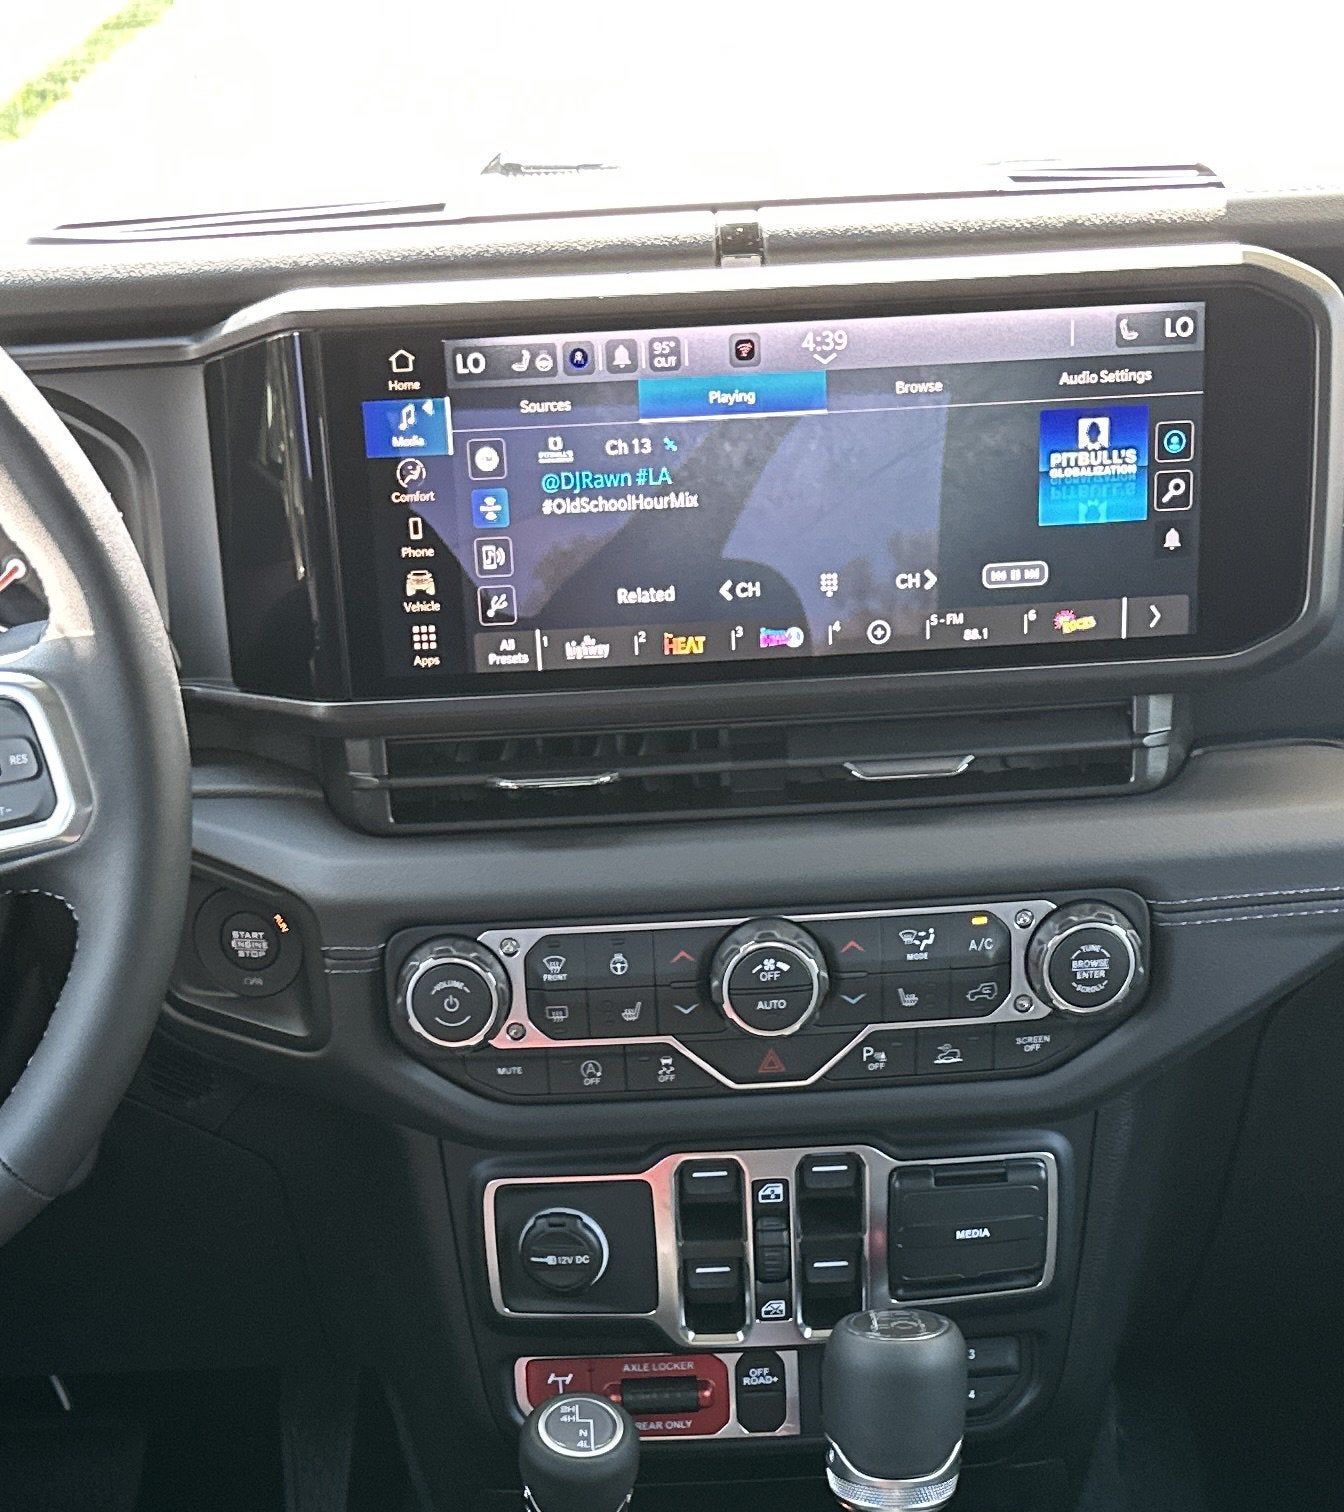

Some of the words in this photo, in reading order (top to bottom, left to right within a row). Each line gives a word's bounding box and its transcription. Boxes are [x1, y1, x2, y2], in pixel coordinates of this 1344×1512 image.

[1164, 316, 1194, 338] LO
[801, 330, 848, 352] 4:39
[653, 341, 676, 355] 95°
[456, 352, 486, 374] LO
[653, 356, 677, 368] OUT
[1059, 369, 1098, 385] Audio
[1099, 367, 1152, 386] Settings
[388, 380, 421, 391] Home
[895, 381, 943, 395] Browse
[708, 389, 756, 406] Playing
[520, 400, 572, 414] Sources
[605, 438, 629, 456] Ch
[632, 437, 652, 454] 13
[1050, 448, 1137, 468] PITBULL'S
[1049, 464, 1137, 479] GLOBALIZATION
[541, 470, 632, 494] @DJRawn
[635, 466, 673, 486] #LA
[391, 491, 435, 503] Comfort
[541, 491, 699, 515] #OldSchoolHourMix
[401, 546, 435, 558] Phone
[895, 573, 921, 589] CH
[617, 585, 675, 605] Related
[735, 581, 761, 598] CH
[403, 600, 441, 613] Vehicle
[500, 638, 515, 651] All
[663, 636, 706, 656] HEAT
[413, 655, 441, 668] Apps
[488, 652, 529, 665] Presets
[9, 754, 28, 765] RES
[231, 930, 265, 939] START
[968, 937, 994, 952] A/C
[238, 950, 266, 958] STOP
[906, 952, 929, 961] MODE
[1071, 958, 1110, 969] BROWSE
[543, 973, 568, 982] FRONT
[759, 971, 781, 982] OFF
[1076, 970, 1106, 980] ENTER
[1075, 984, 1105, 993] SCROLL
[756, 1000, 787, 1010] AUTO
[1016, 1035, 1051, 1045] SCREEN
[1023, 1044, 1041, 1052] OFF
[497, 1066, 523, 1076] MUTE
[867, 1063, 886, 1071] OFF
[584, 1077, 601, 1086] OFF
[657, 1073, 676, 1083] OFF
[956, 1227, 991, 1241] MEDIA
[557, 1255, 574, 1265] 12V
[575, 1254, 590, 1264] DC
[968, 1348, 976, 1360] 3
[622, 1362, 649, 1373] AXLE
[652, 1361, 695, 1371] LOCKER
[749, 1367, 770, 1377] OFF
[742, 1375, 779, 1386] ROAD+
[968, 1389, 976, 1399] 4
[559, 1414, 576, 1423] 4H
[635, 1421, 662, 1431] REAR
[665, 1419, 693, 1430] ONLY
[578, 1429, 588, 1437] N
[576, 1440, 591, 1449] 4L
